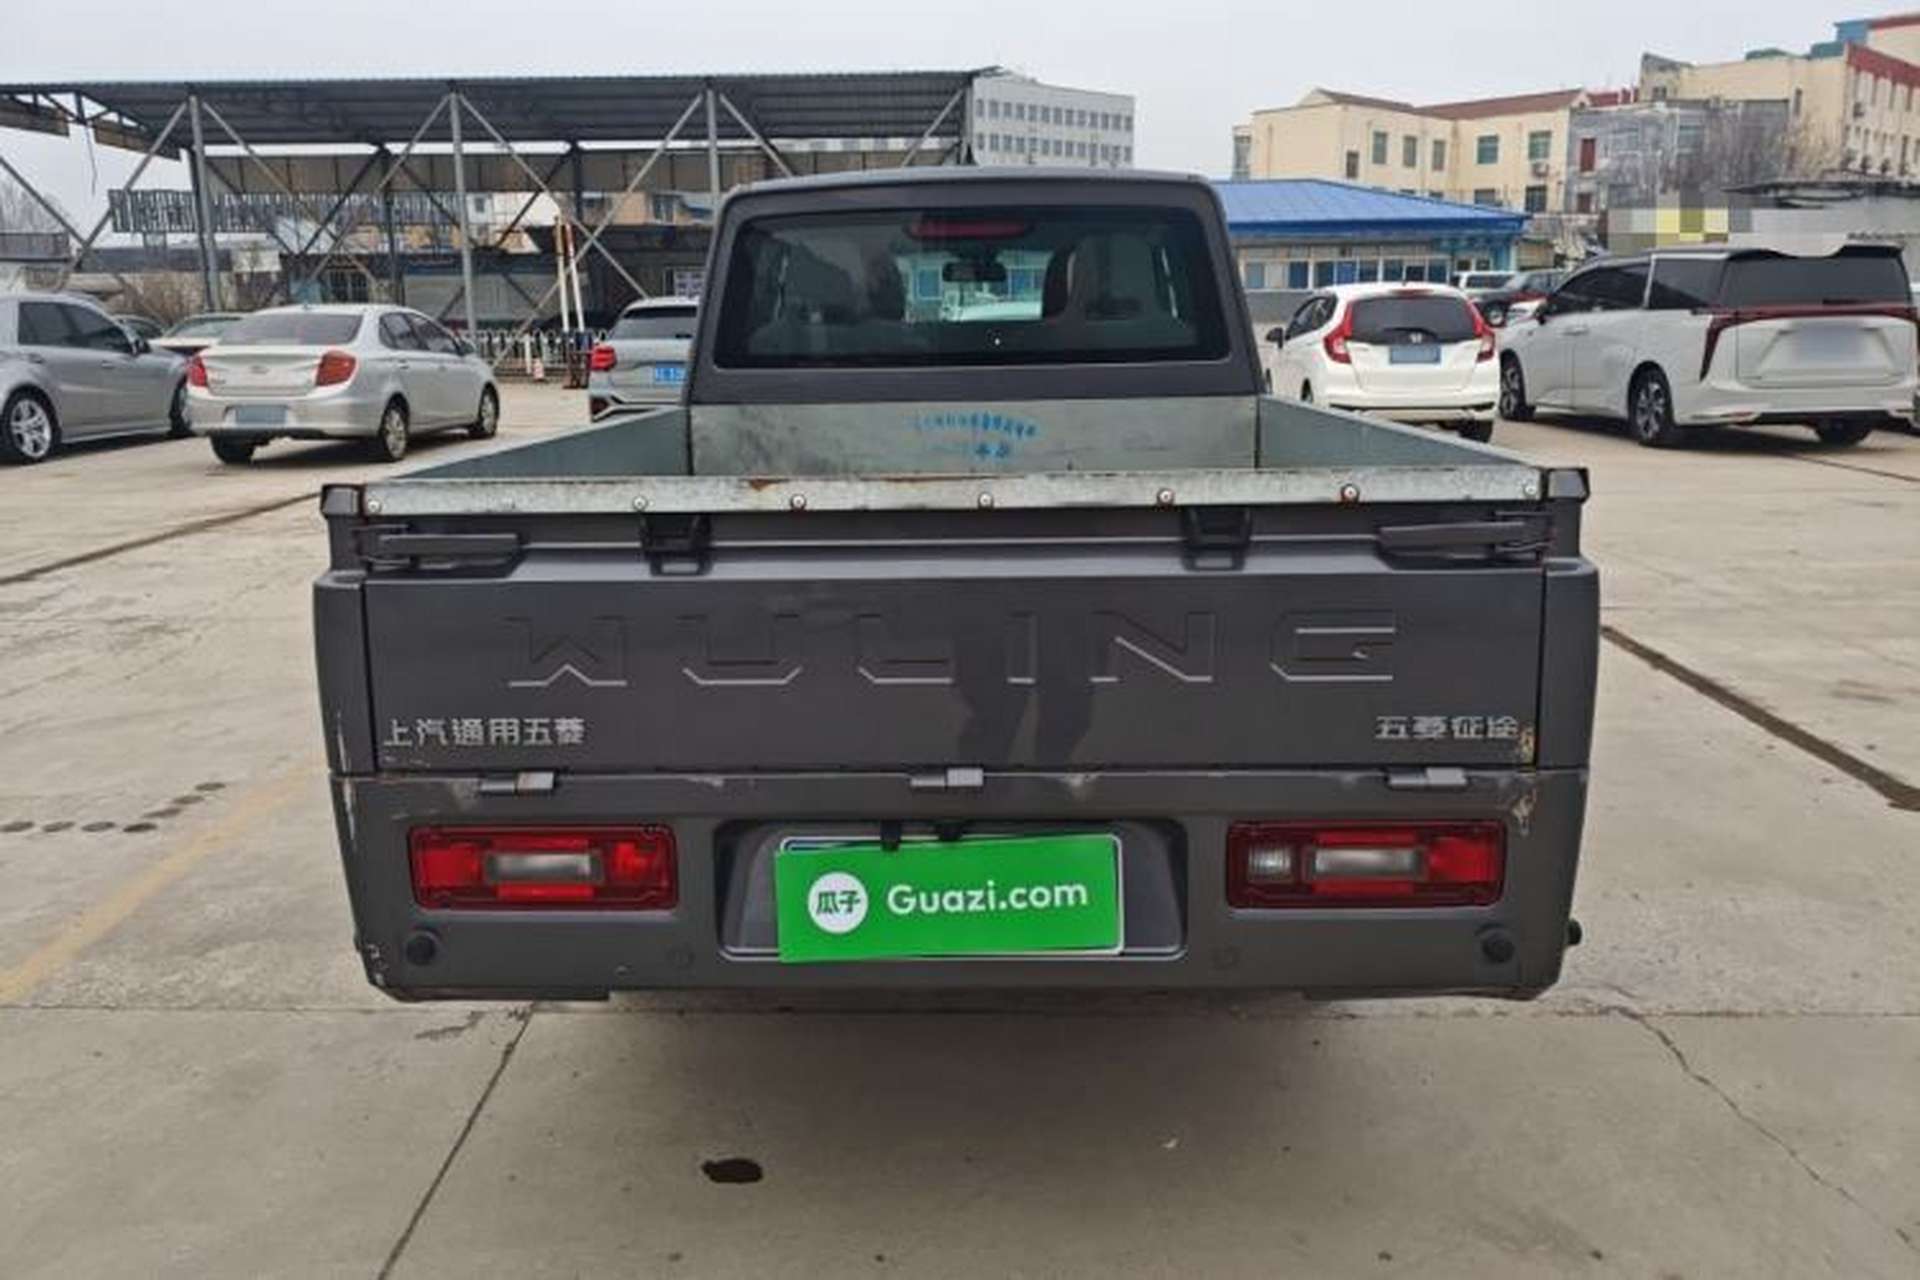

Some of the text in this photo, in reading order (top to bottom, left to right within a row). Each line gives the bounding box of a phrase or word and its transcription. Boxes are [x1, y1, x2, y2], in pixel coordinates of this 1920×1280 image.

[504, 609, 1396, 686] WULING
[383, 717, 586, 747] 上汽通用五菱
[1375, 715, 1520, 740] 五菱征途
[815, 889, 861, 915] 瓜子
[887, 879, 1089, 915] Guazi.com
